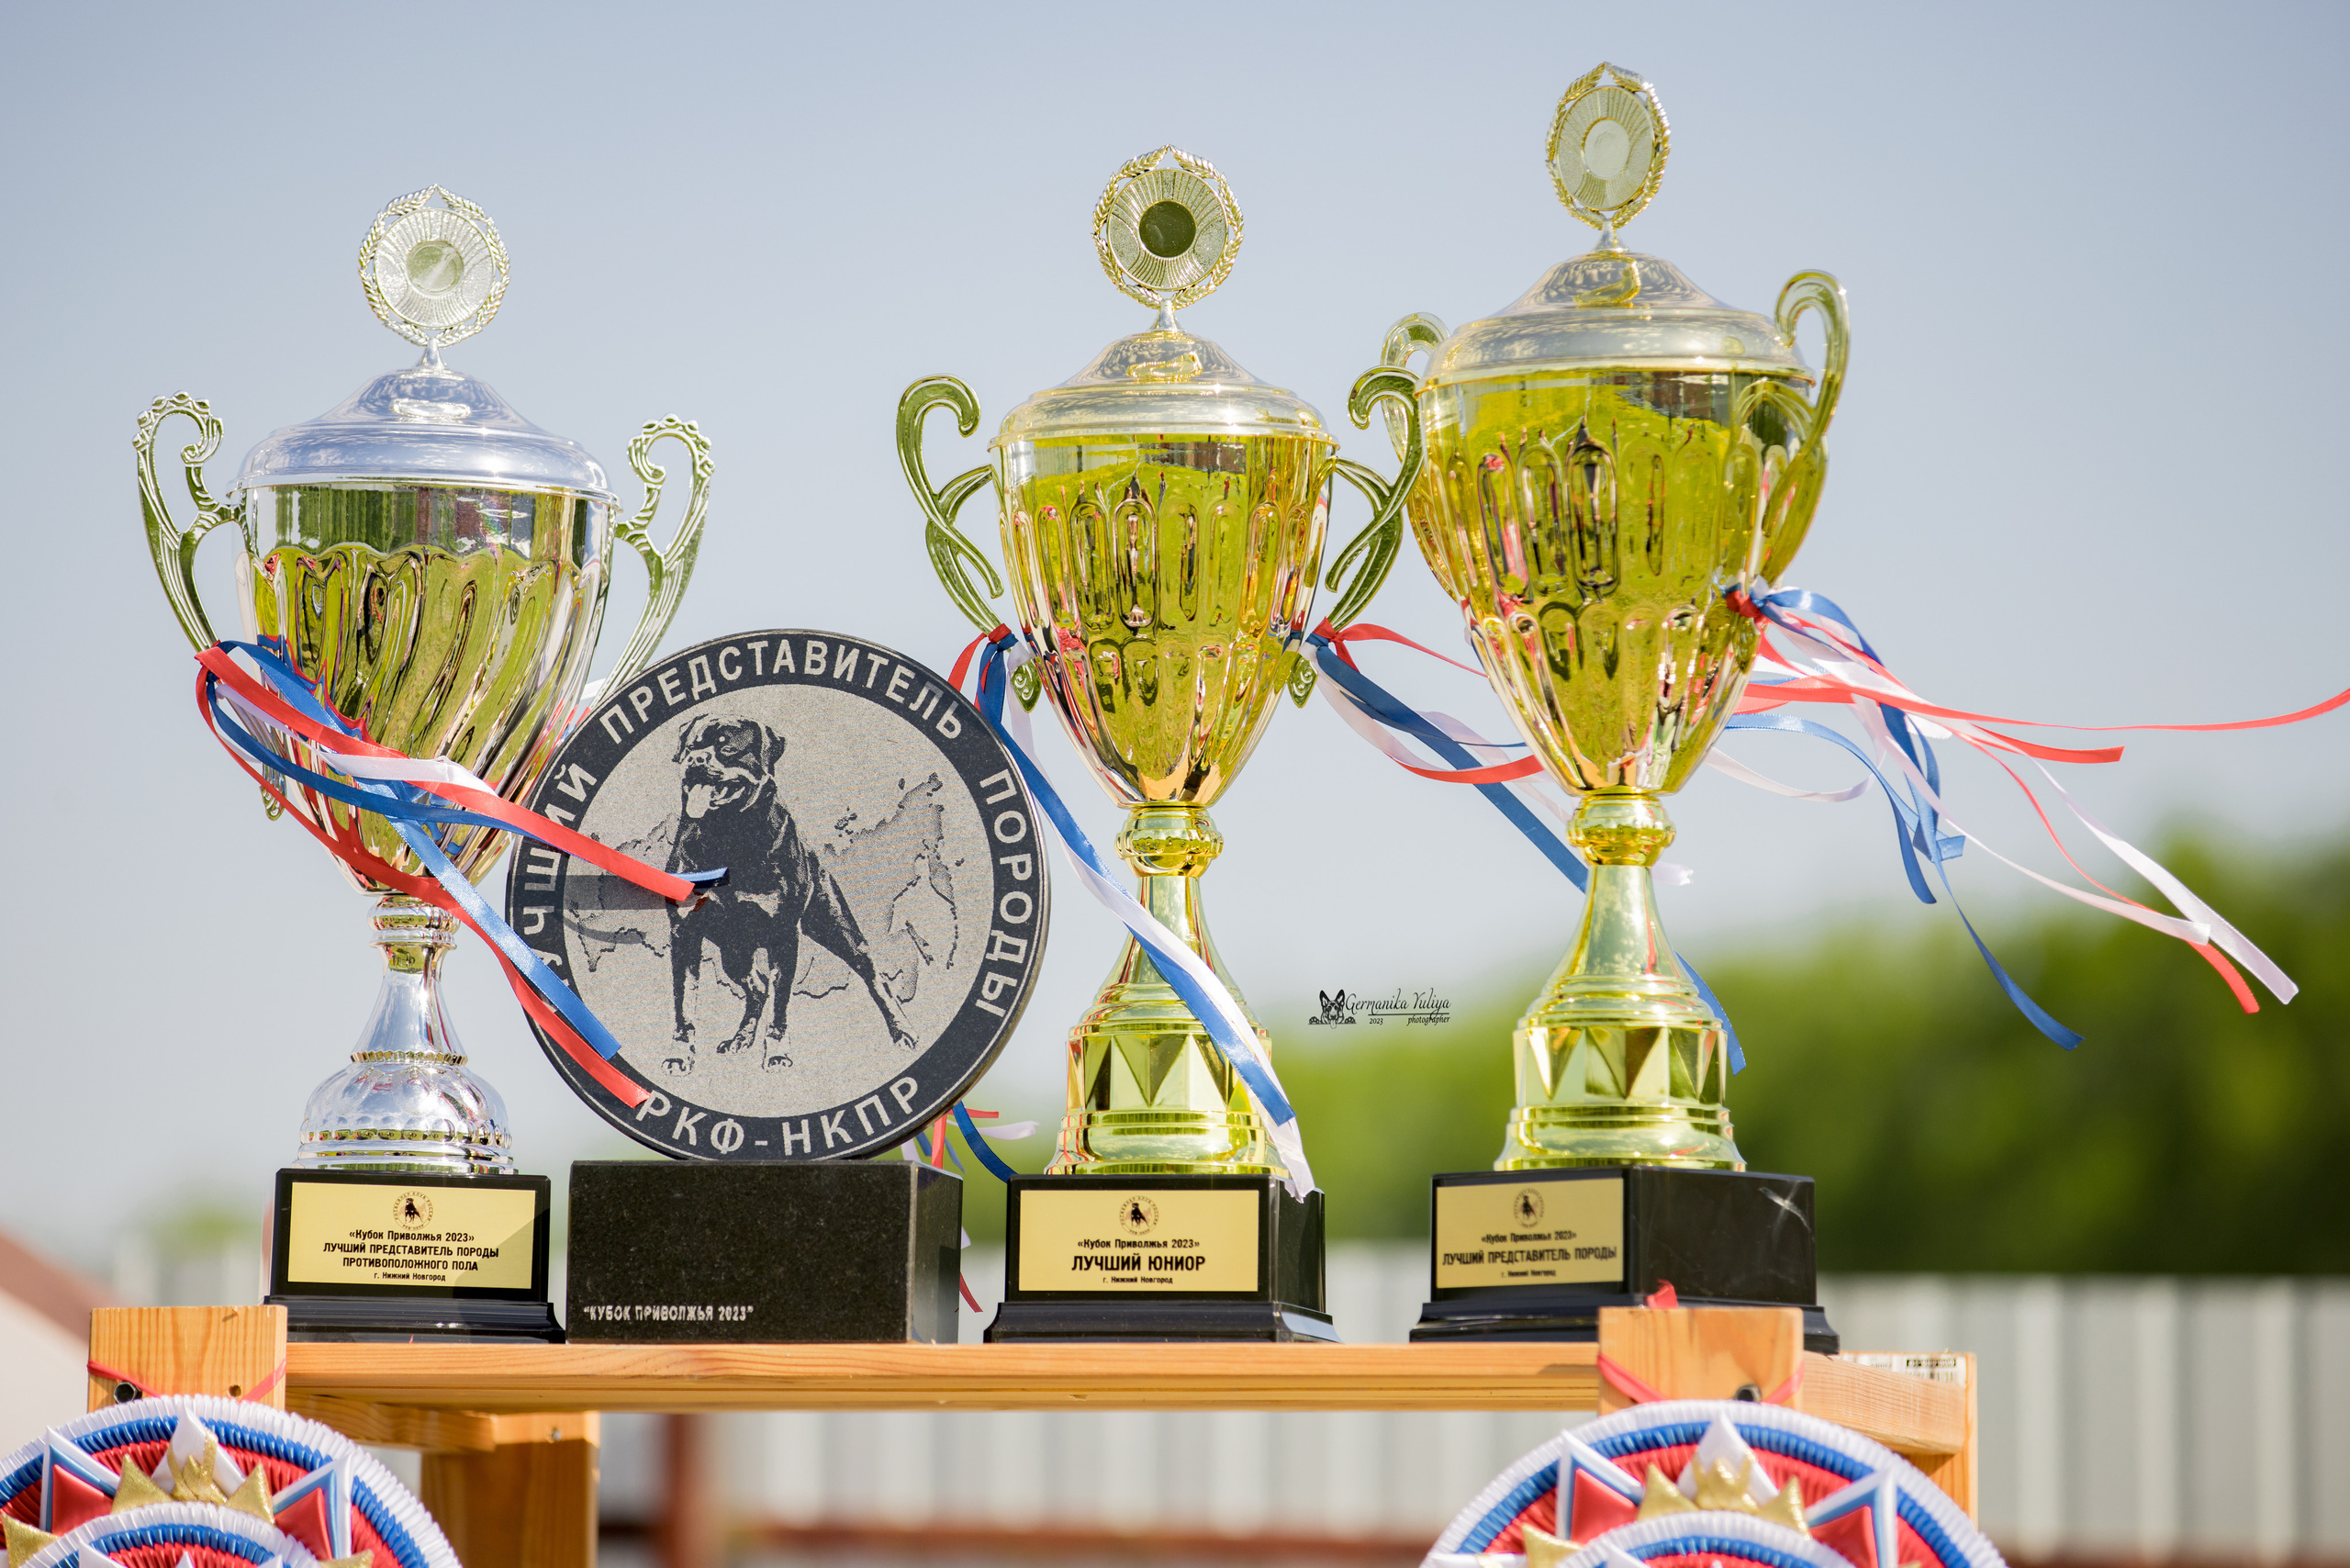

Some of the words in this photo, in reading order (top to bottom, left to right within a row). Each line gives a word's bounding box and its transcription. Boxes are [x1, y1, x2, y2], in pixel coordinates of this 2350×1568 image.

[599, 638, 962, 744] ПРЕДСТАВИТЕЛЬ
[976, 768, 1032, 1018] ПОРОДЫ
[349, 1229, 384, 1241] «Кубок
[387, 1231, 442, 1242] Приволжья
[445, 1232, 475, 1242] 2023»
[1481, 1233, 1507, 1244] «Кубок
[1510, 1232, 1551, 1243] Приволжья
[1554, 1230, 1577, 1240] 2023»
[323, 1241, 365, 1254] ЛУЧШИЙ
[369, 1244, 453, 1257] ПРЕДСТАВИТЕЛЬ
[456, 1247, 499, 1259] ПОРОДЫ
[1077, 1238, 1111, 1250] «Кубок
[1114, 1239, 1168, 1249] Приволжья
[1171, 1239, 1200, 1249] 2023»
[1071, 1253, 1141, 1271] ЛУЧШИЙ
[1148, 1256, 1205, 1271] ЮНИОР
[1442, 1249, 1484, 1266] ЛУЧШИЙ
[1488, 1247, 1571, 1265] ПРЕДСТАВИТЕЛЬ
[1574, 1246, 1617, 1260] ПОРОДЫ
[342, 1257, 448, 1271] ПРОТИВОПОЛОЖНОГО
[452, 1260, 478, 1271] ПОЛА
[382, 1271, 409, 1281] Нижний
[412, 1272, 446, 1282] Новгород
[1111, 1275, 1138, 1283] Нижний
[1140, 1276, 1173, 1285] Новгород
[635, 1305, 713, 1321] ПРИВОЛЖЬЯ
